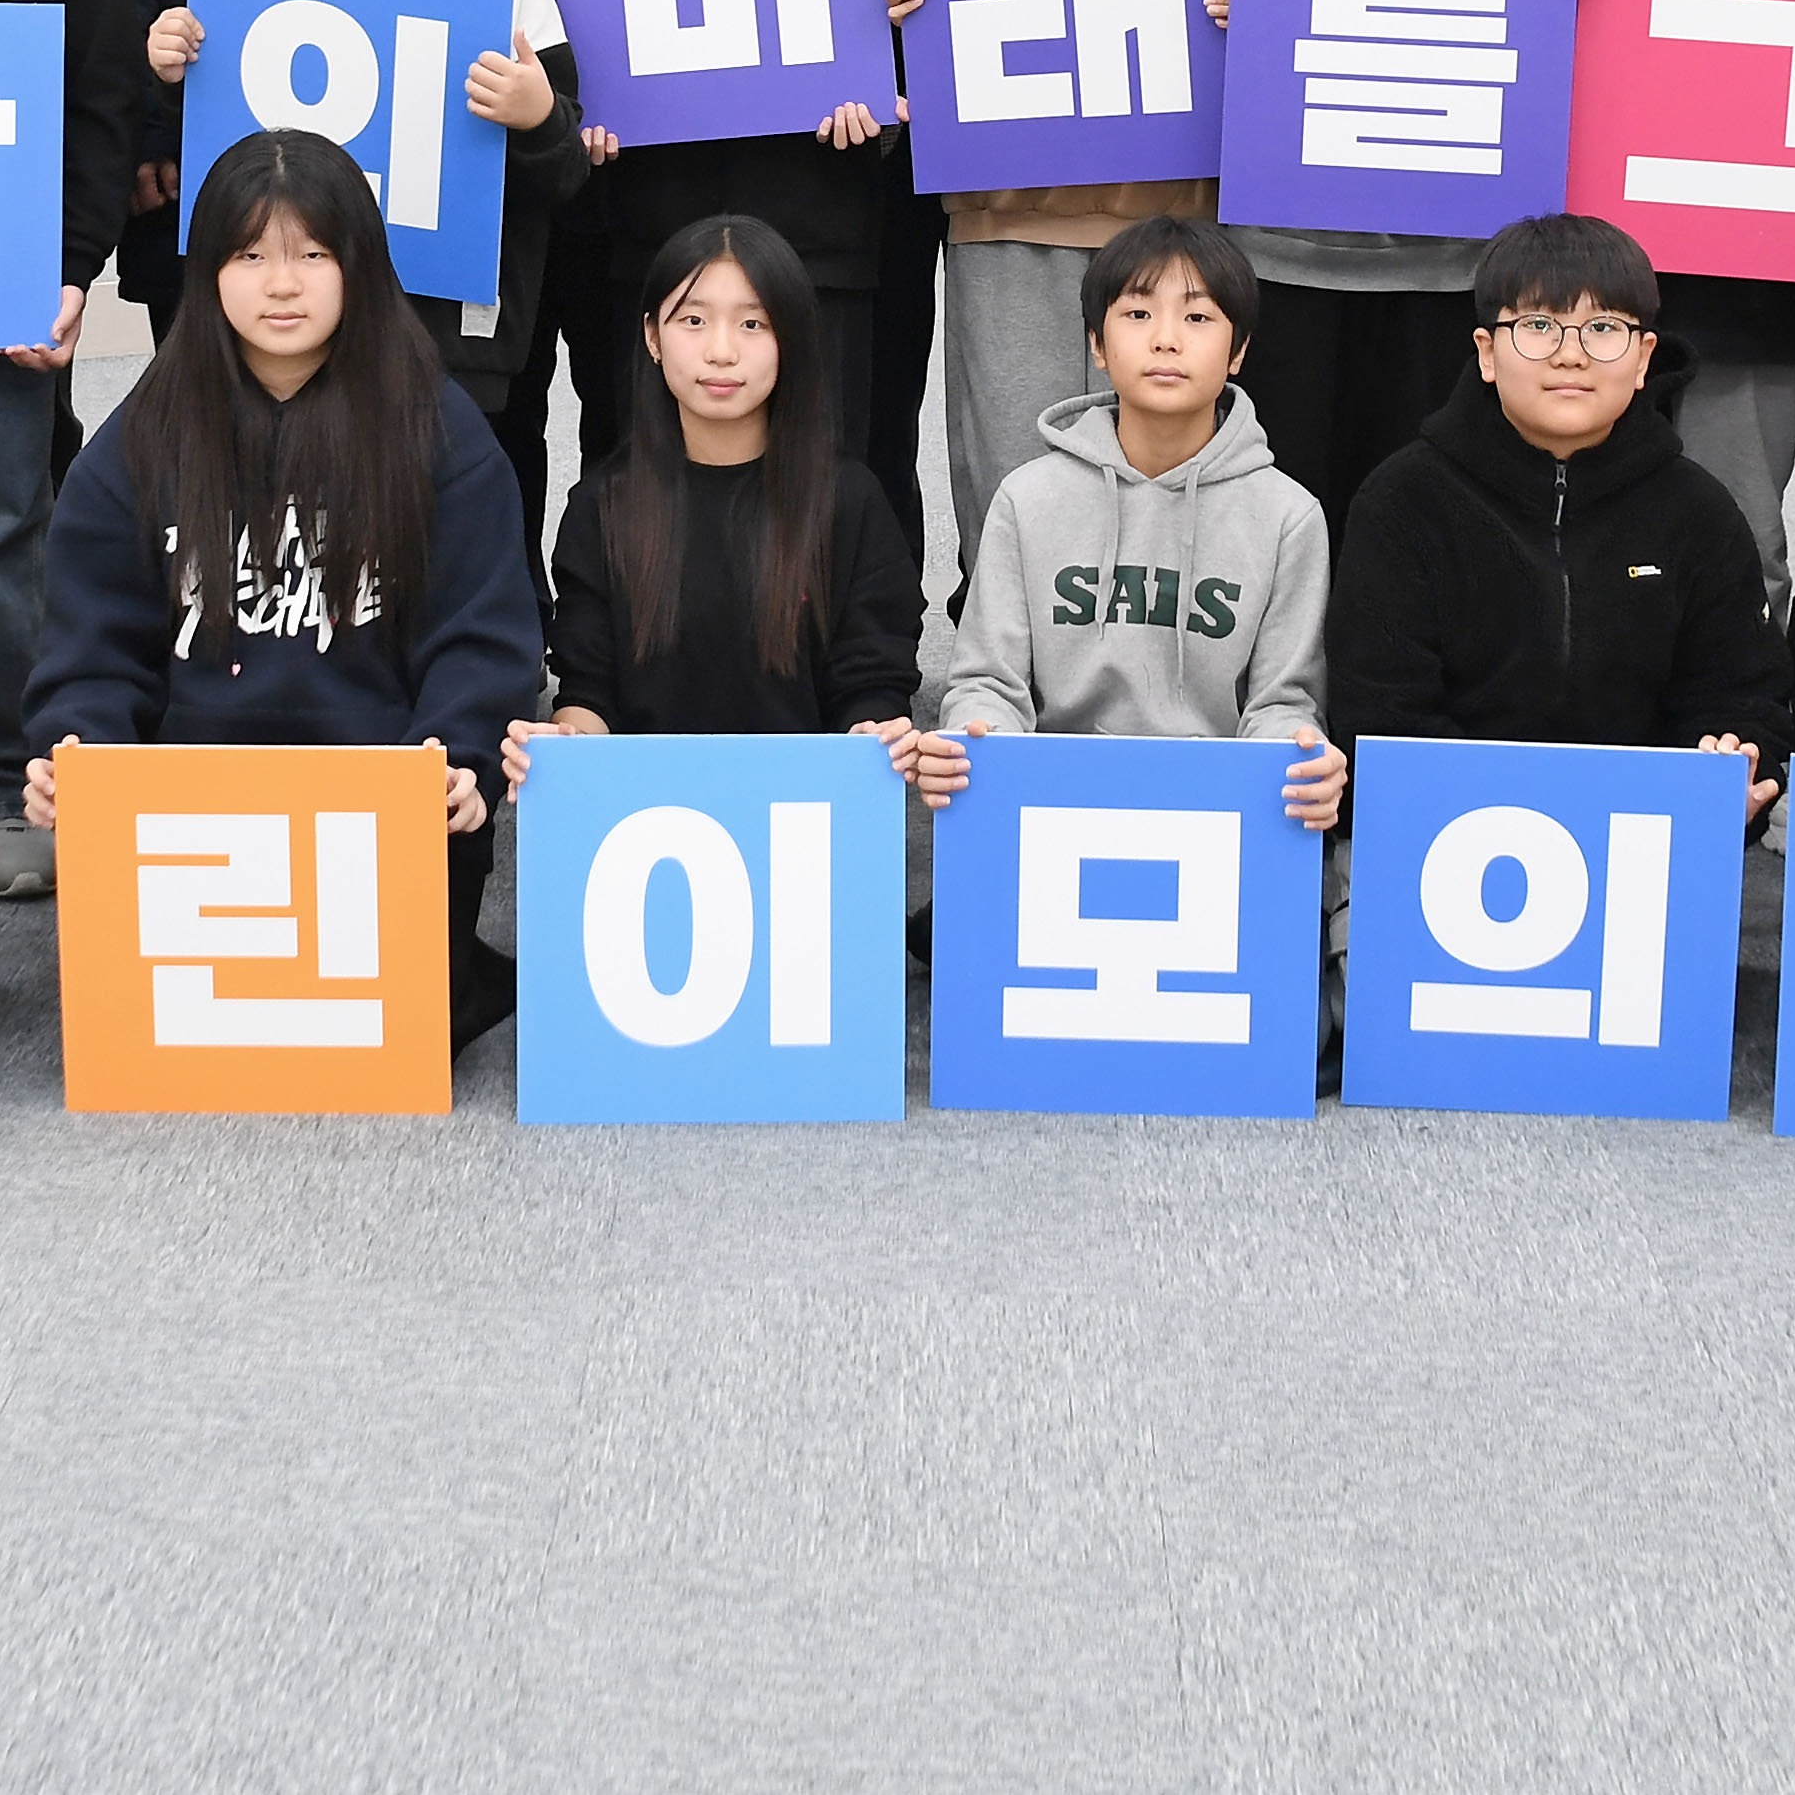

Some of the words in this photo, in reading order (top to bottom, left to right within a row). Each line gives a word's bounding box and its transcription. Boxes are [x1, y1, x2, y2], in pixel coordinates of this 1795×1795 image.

[136, 811, 384, 1047] 린
[583, 801, 831, 1047] 이
[1002, 806, 1251, 1044] 모
[1410, 806, 1672, 1047] 의
